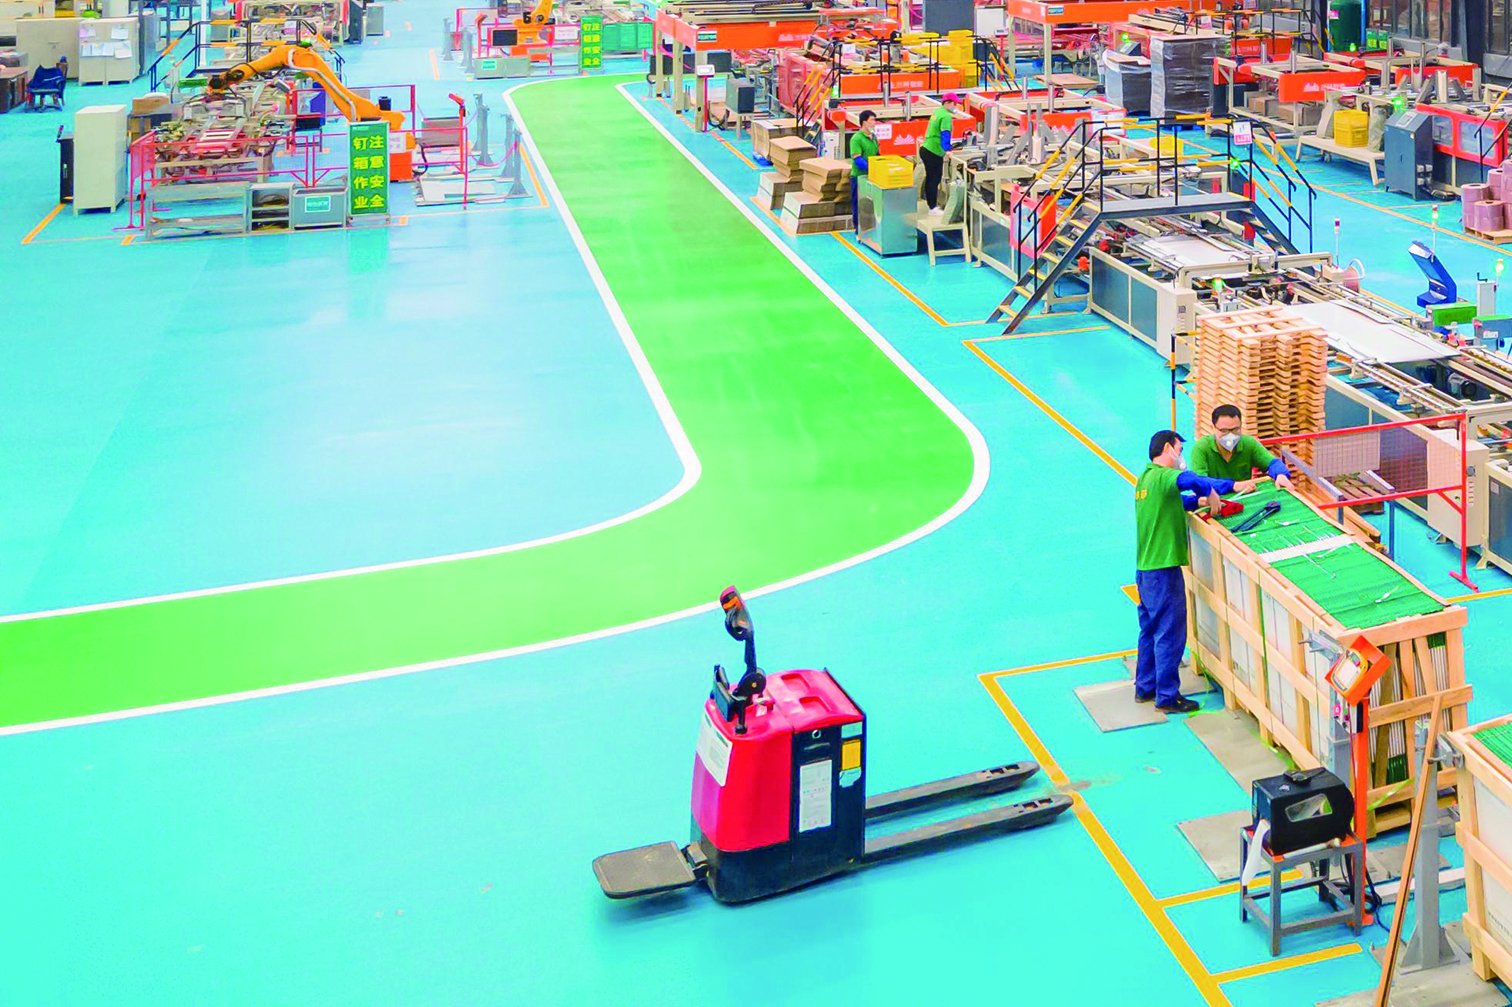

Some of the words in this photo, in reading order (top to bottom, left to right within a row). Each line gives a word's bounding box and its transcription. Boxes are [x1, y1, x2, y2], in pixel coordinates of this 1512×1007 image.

[353, 136, 369, 209] 钉箱作业
[369, 135, 385, 208] 注意安全
